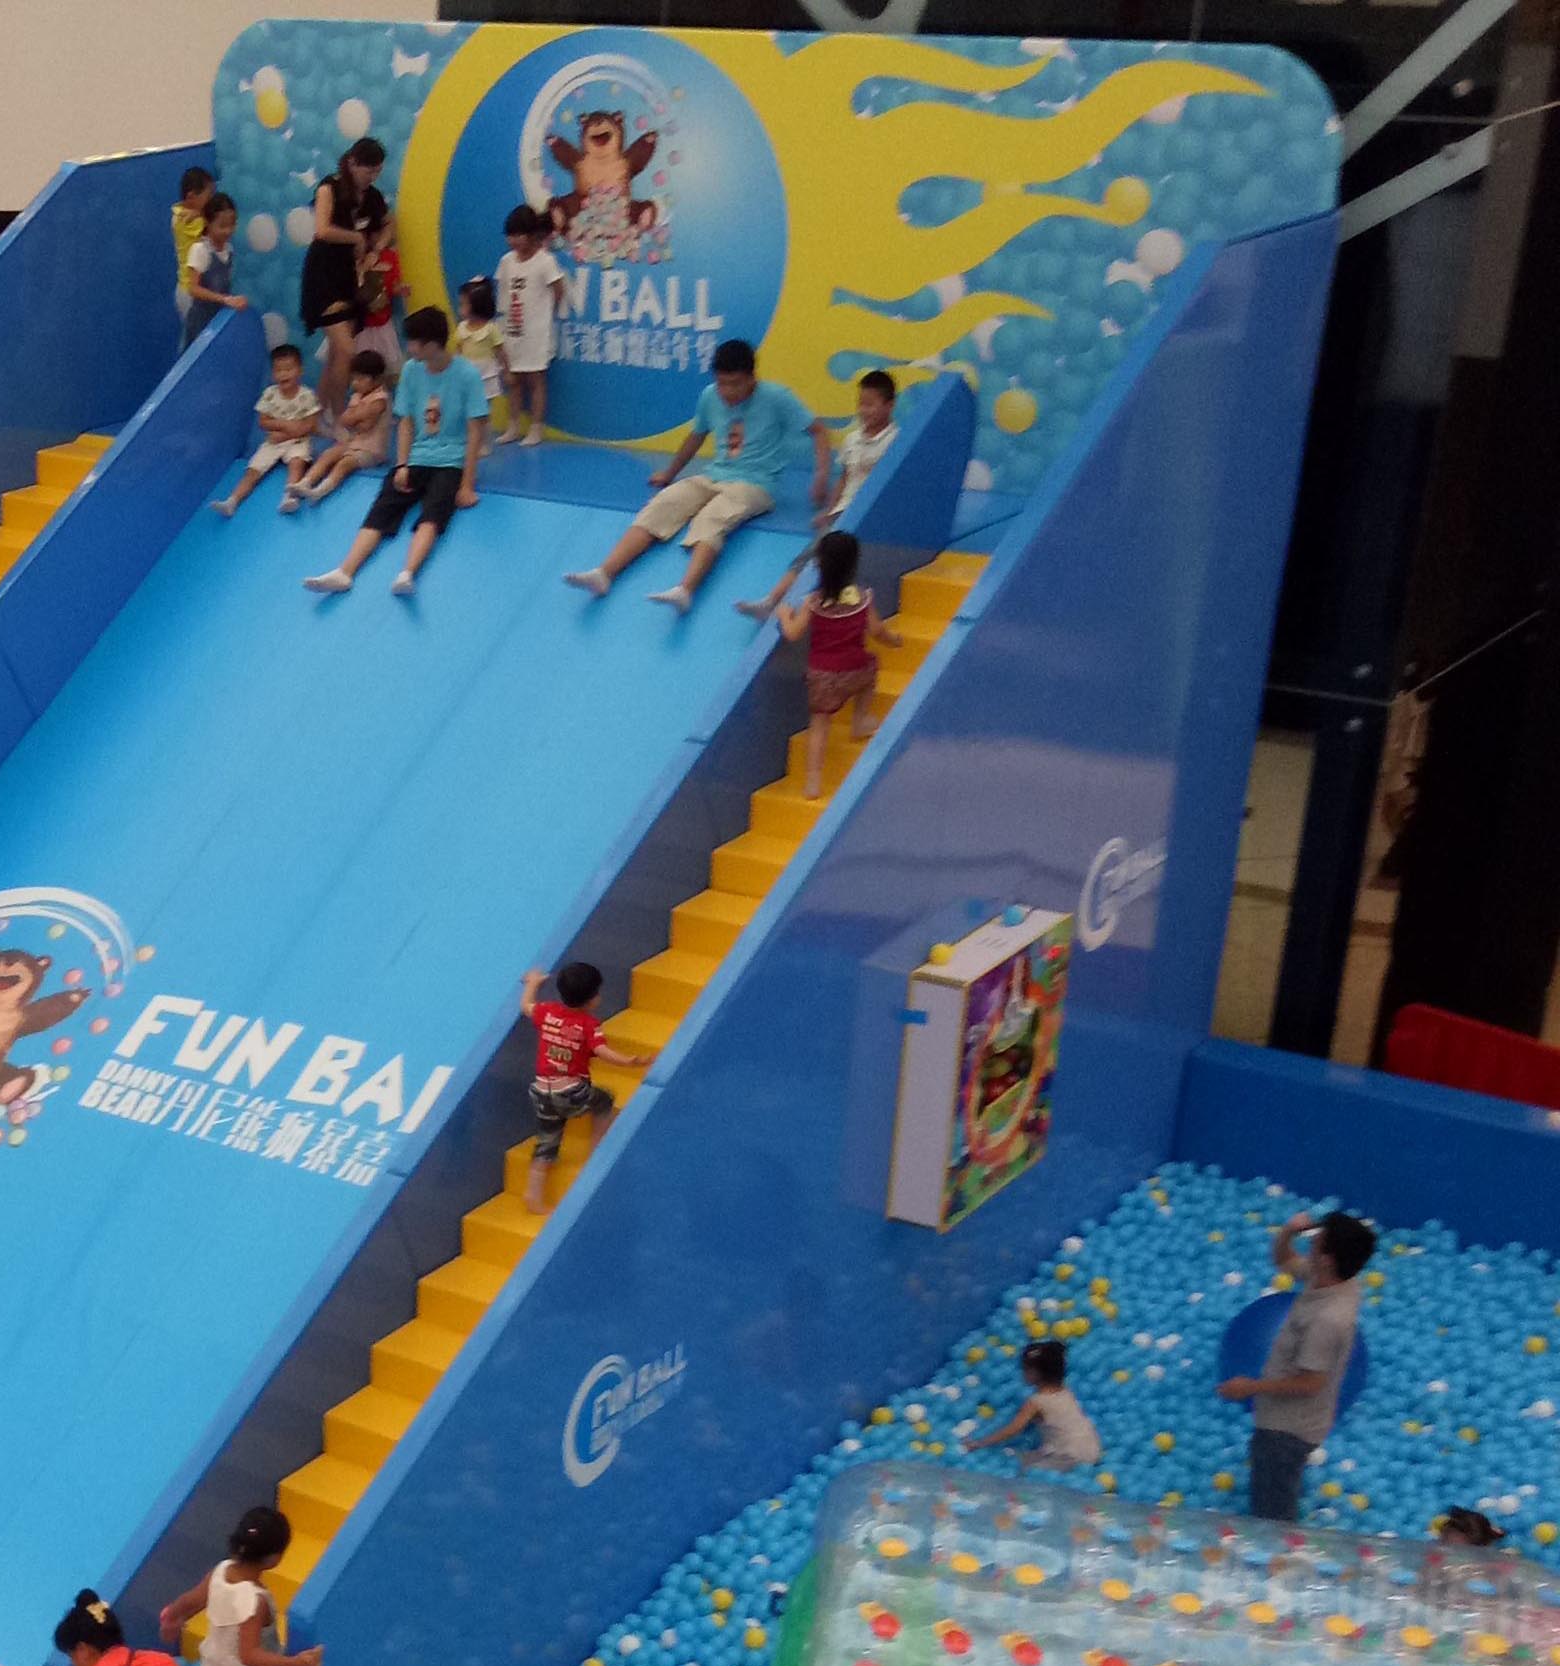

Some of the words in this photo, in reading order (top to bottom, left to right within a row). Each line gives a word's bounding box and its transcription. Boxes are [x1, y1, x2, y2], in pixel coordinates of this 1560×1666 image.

[600, 270, 725, 331] BALL
[113, 994, 304, 1089] FUN
[81, 1080, 165, 1125] BEAR
[95, 1059, 178, 1096] DANNY
